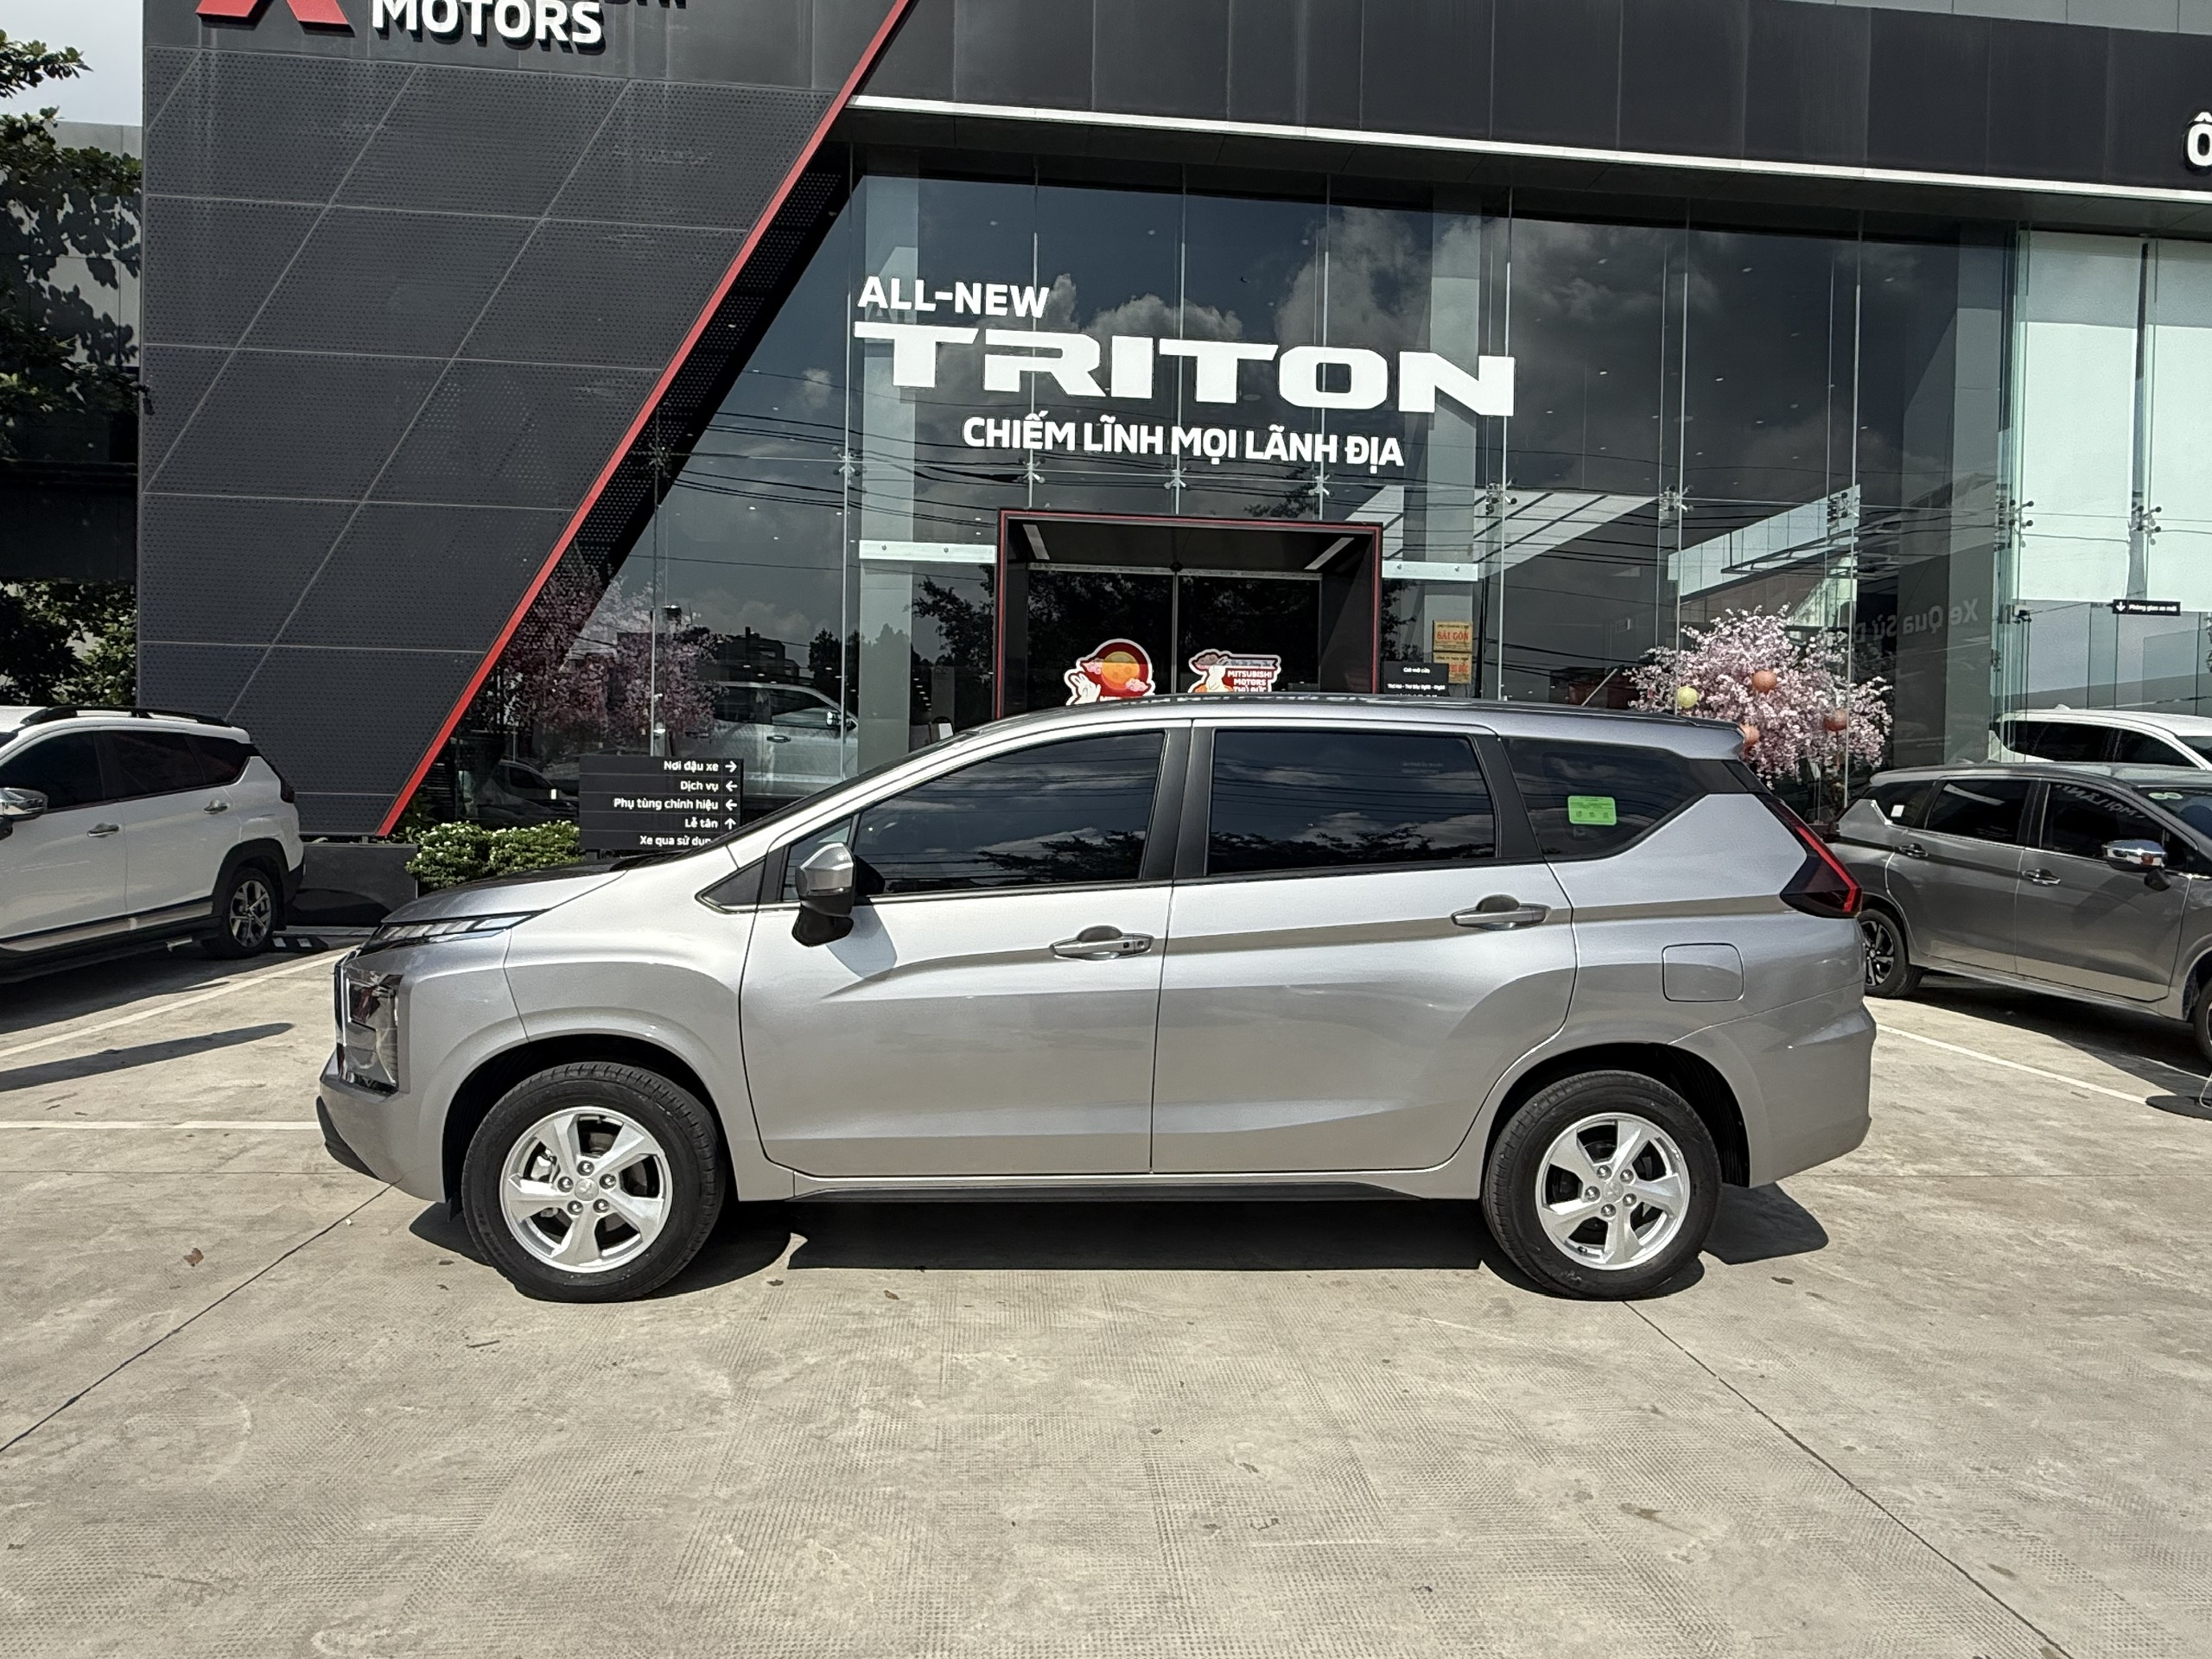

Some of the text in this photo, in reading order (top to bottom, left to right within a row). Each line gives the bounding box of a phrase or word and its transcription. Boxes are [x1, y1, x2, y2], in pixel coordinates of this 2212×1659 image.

[372, 0, 602, 44] MOTORS
[857, 276, 1050, 319] ALL-NEW
[854, 321, 1515, 416] TRITON
[963, 410, 1405, 474] CHIẾM LĨNH MỌI LÃNH ĐỊA
[664, 760, 719, 773] Nơi đậu xe
[680, 780, 719, 792] Dịch vụ
[613, 798, 719, 811] Phụ tùng chính hiệu
[685, 817, 718, 829] Lễ tân
[639, 835, 653, 845] Xe
[655, 836, 675, 847] qua
[677, 835, 690, 845] sử
